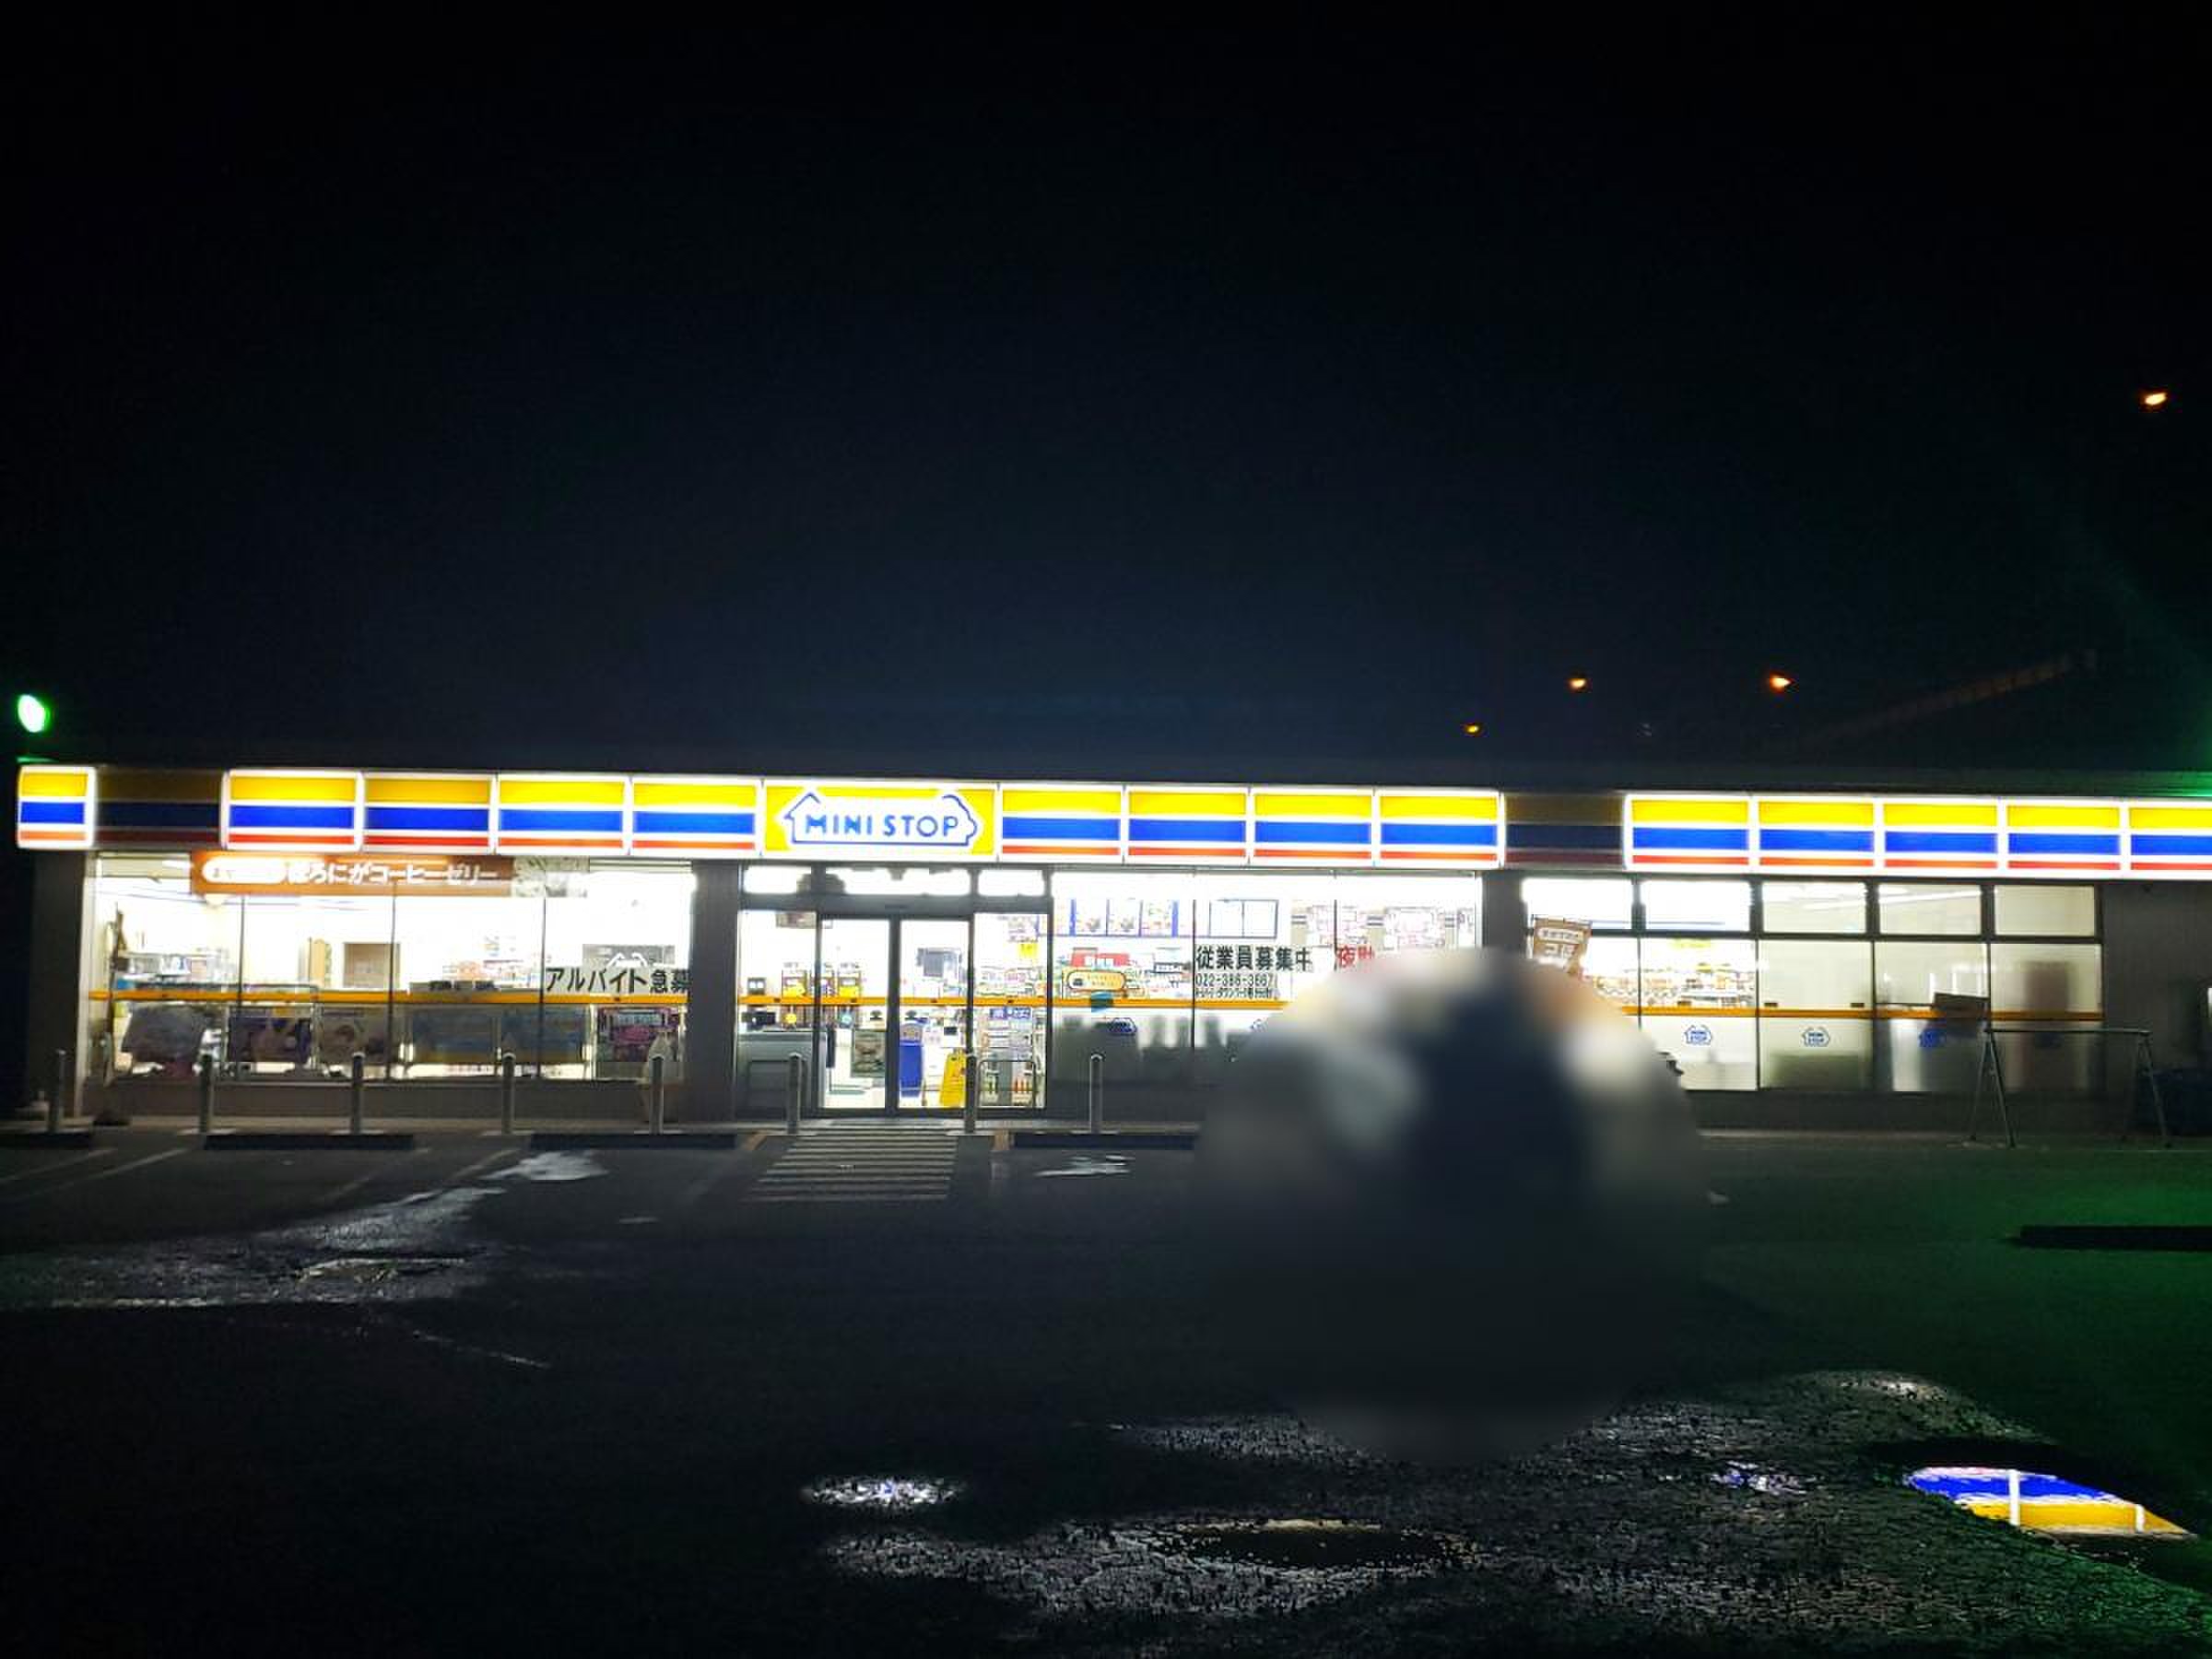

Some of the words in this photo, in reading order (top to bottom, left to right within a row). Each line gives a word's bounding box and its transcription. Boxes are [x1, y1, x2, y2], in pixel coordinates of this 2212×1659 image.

[805, 814, 873, 835] MINI
[883, 815, 959, 837] STOP
[1195, 945, 1312, 971] 従業員募集中
